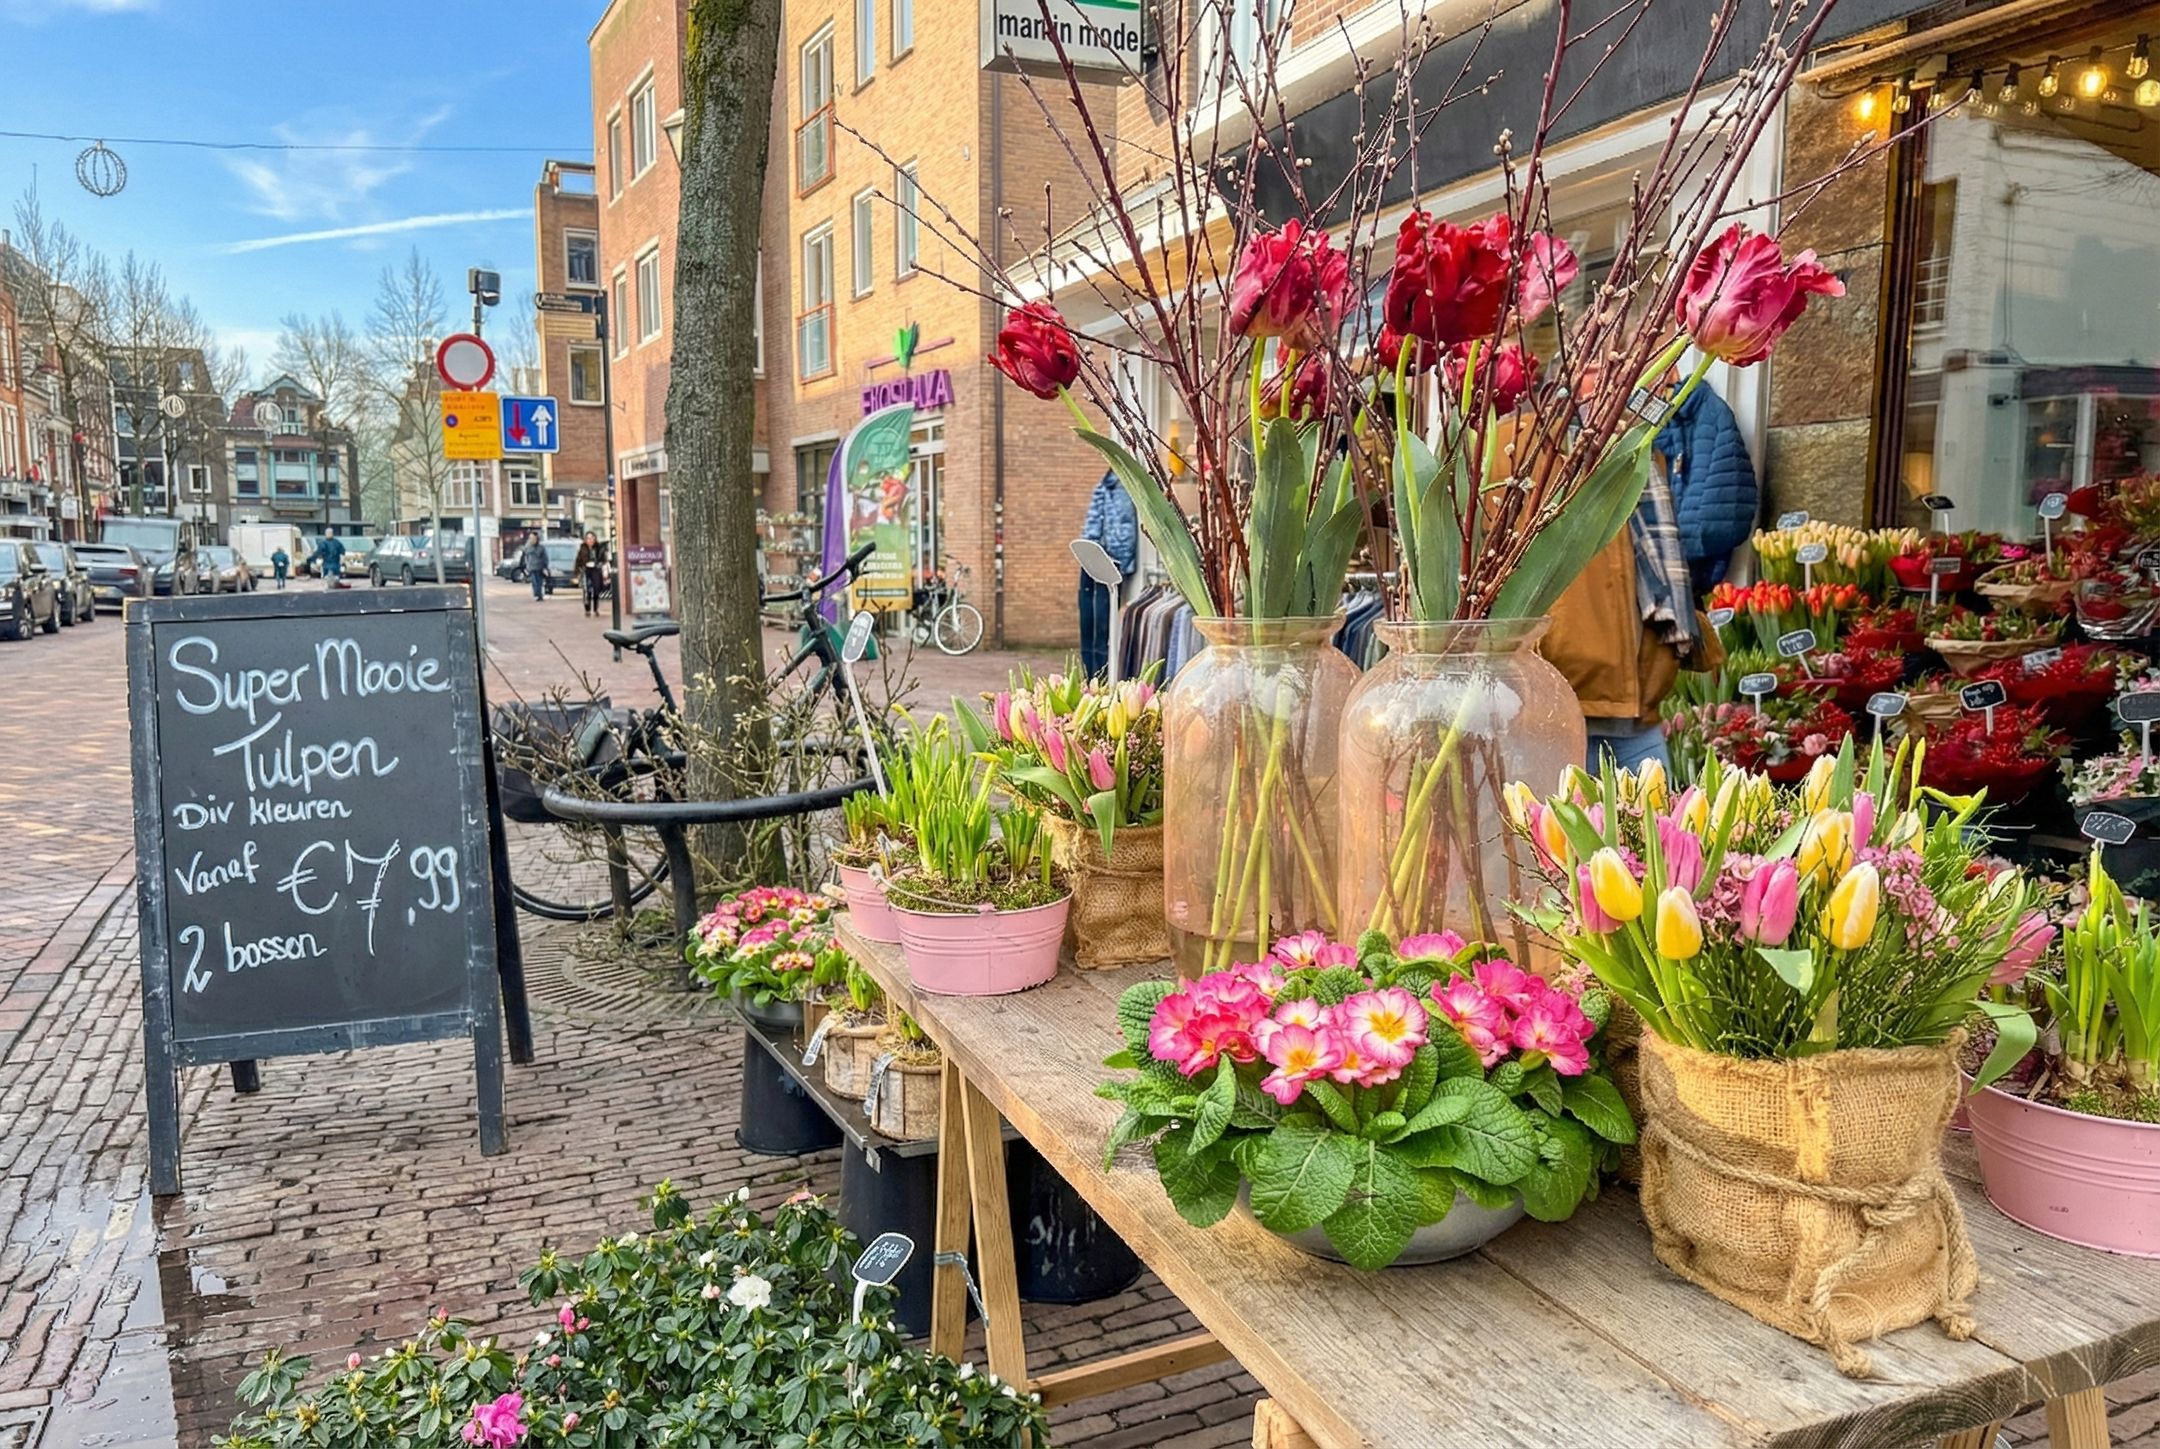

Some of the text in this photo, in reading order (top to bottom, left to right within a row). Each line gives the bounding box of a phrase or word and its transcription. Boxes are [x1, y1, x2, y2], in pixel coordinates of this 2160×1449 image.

[1079, 22, 1139, 52] mode
[169, 636, 451, 725] Super Mooie
[213, 711, 399, 794] Tulpen
[173, 794, 352, 830] Div kleuren
[175, 838, 260, 896] Vanaf
[179, 925, 213, 993] 2
